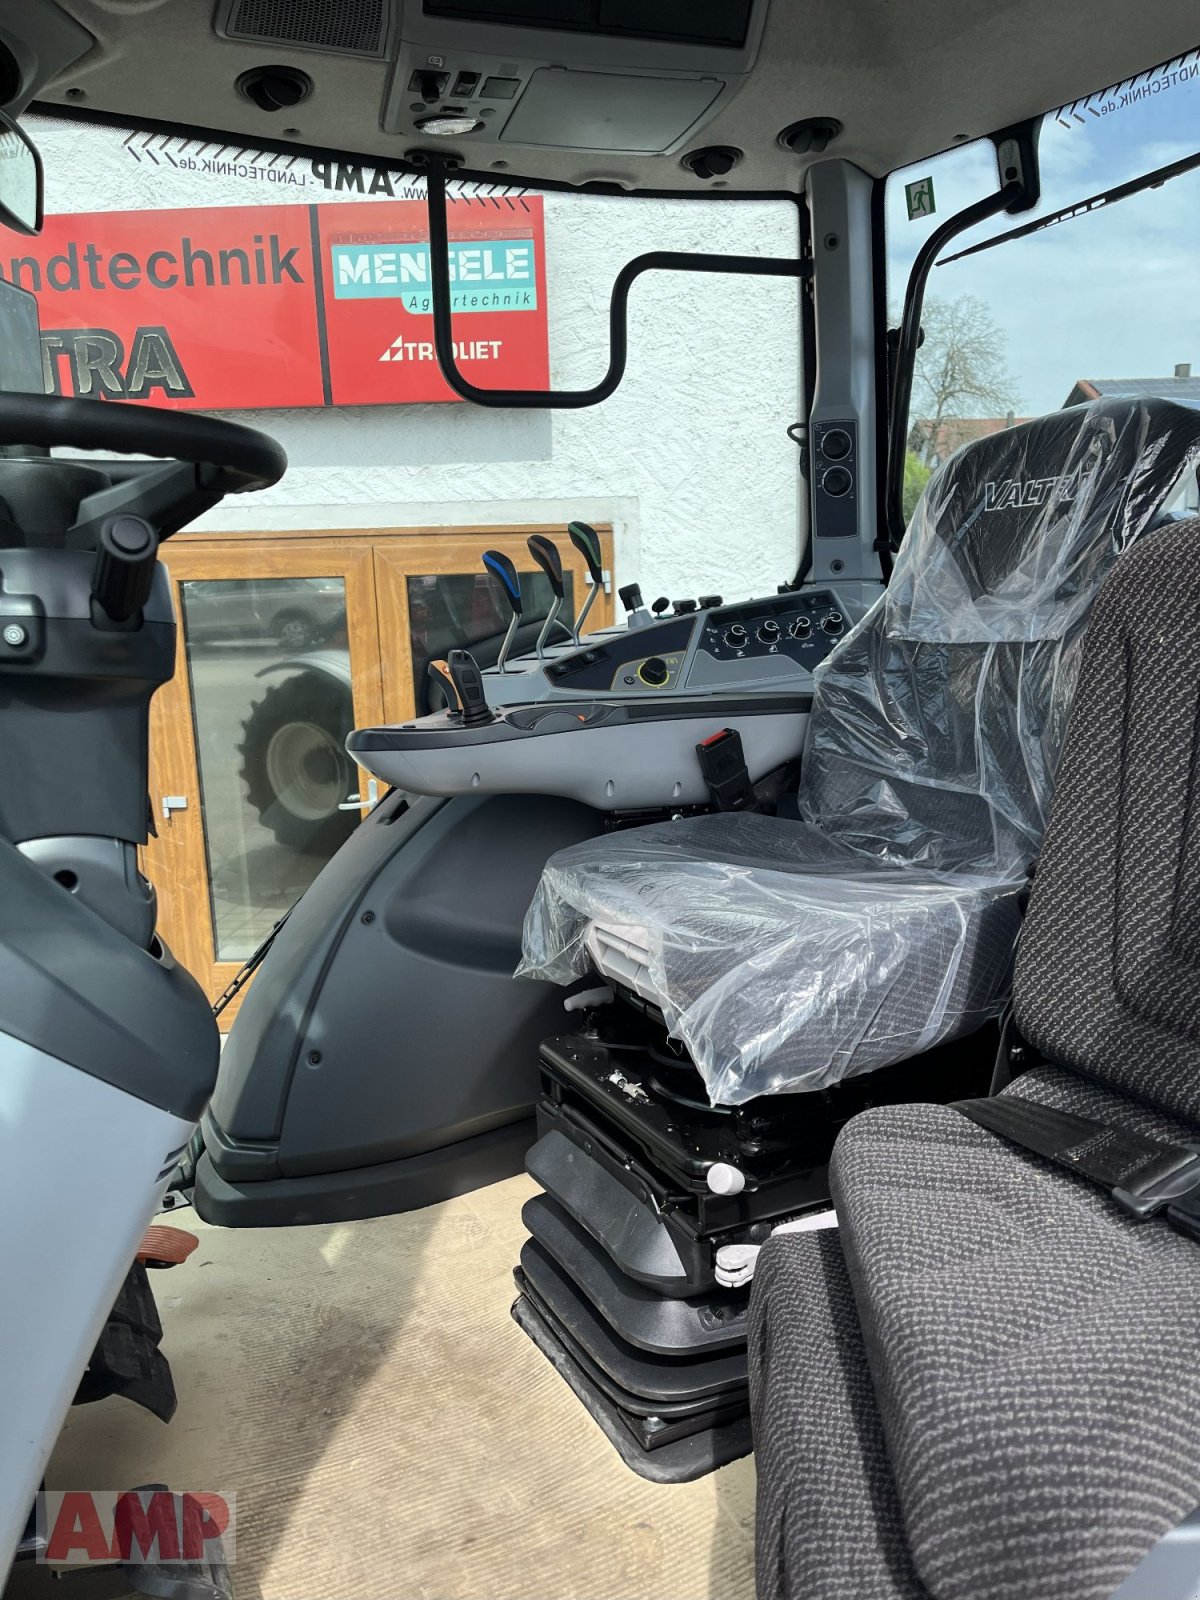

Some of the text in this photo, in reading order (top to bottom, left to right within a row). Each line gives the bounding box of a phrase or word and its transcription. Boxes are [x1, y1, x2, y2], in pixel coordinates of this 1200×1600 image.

[0, 234, 304, 292] ndtechnik
[409, 292, 531, 311] Agrtechnik
[404, 341, 503, 361] TRLIET
